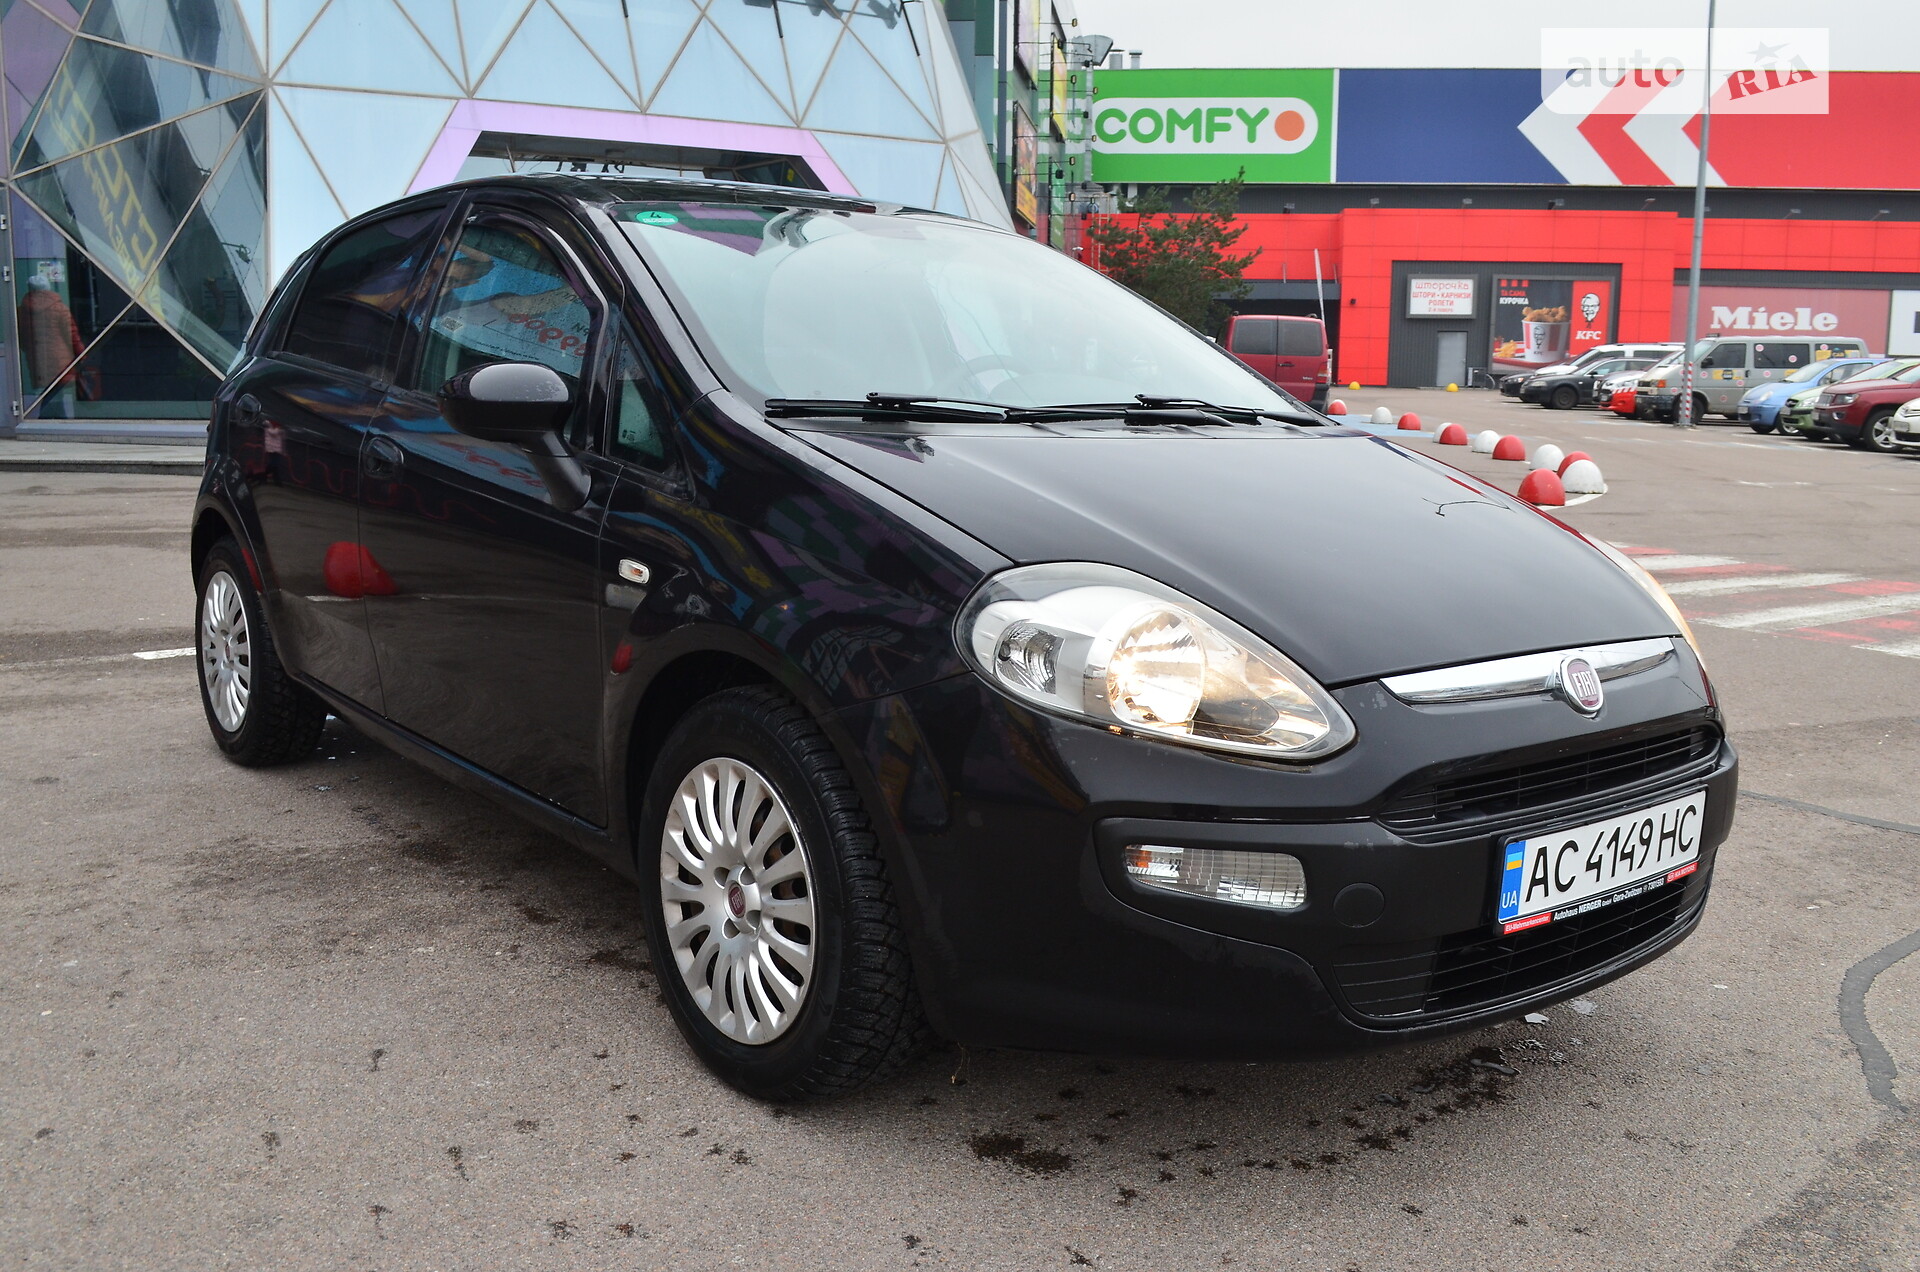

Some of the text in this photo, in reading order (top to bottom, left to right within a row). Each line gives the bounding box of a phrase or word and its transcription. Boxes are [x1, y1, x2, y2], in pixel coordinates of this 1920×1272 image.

[1094, 107, 1270, 144] COMFY
[1499, 297, 1529, 305] КУРОЧКА
[1710, 306, 1839, 332] Miele
[1575, 330, 1602, 340] KFC
[1571, 670, 1597, 698] FIAT
[1525, 804, 1697, 902] AC 4149 HC
[1501, 890, 1518, 909] UA
[1553, 907, 1578, 921] Autohaus
